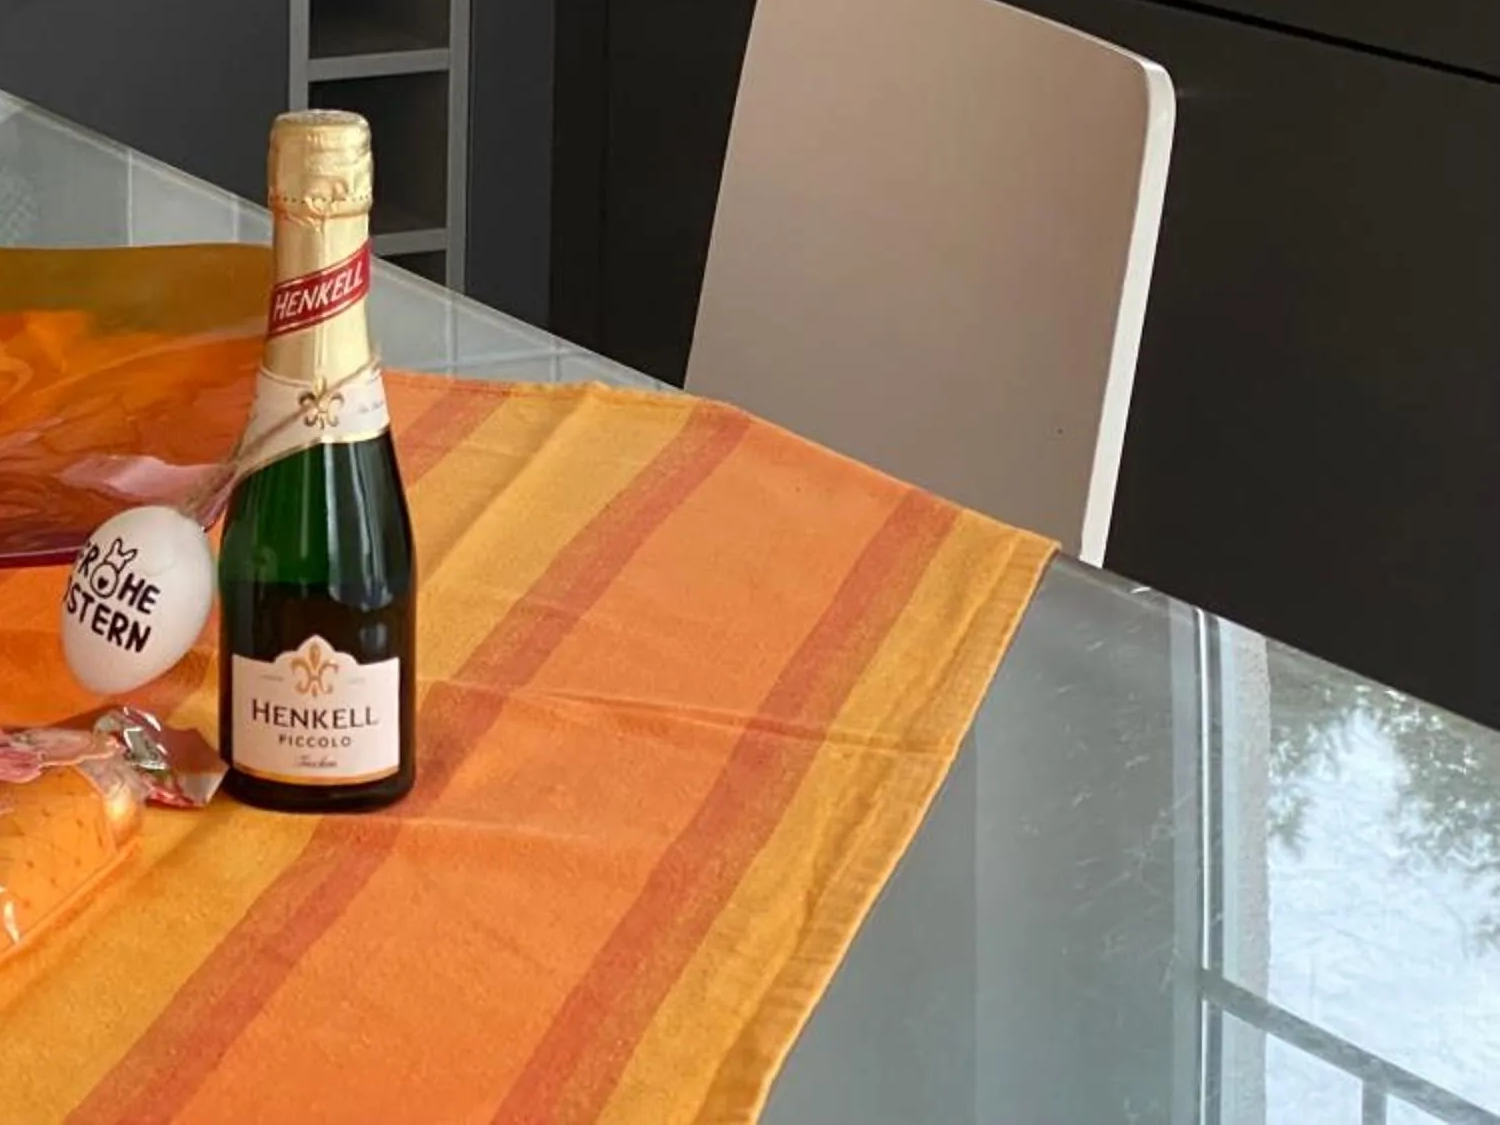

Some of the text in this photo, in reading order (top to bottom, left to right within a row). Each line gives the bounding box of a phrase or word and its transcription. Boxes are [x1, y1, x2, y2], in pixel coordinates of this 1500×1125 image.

[272, 260, 363, 321] HENKELL
[78, 537, 161, 615] ROHE
[251, 698, 380, 730] HENKELL
[278, 733, 352, 748] PICCOLO
